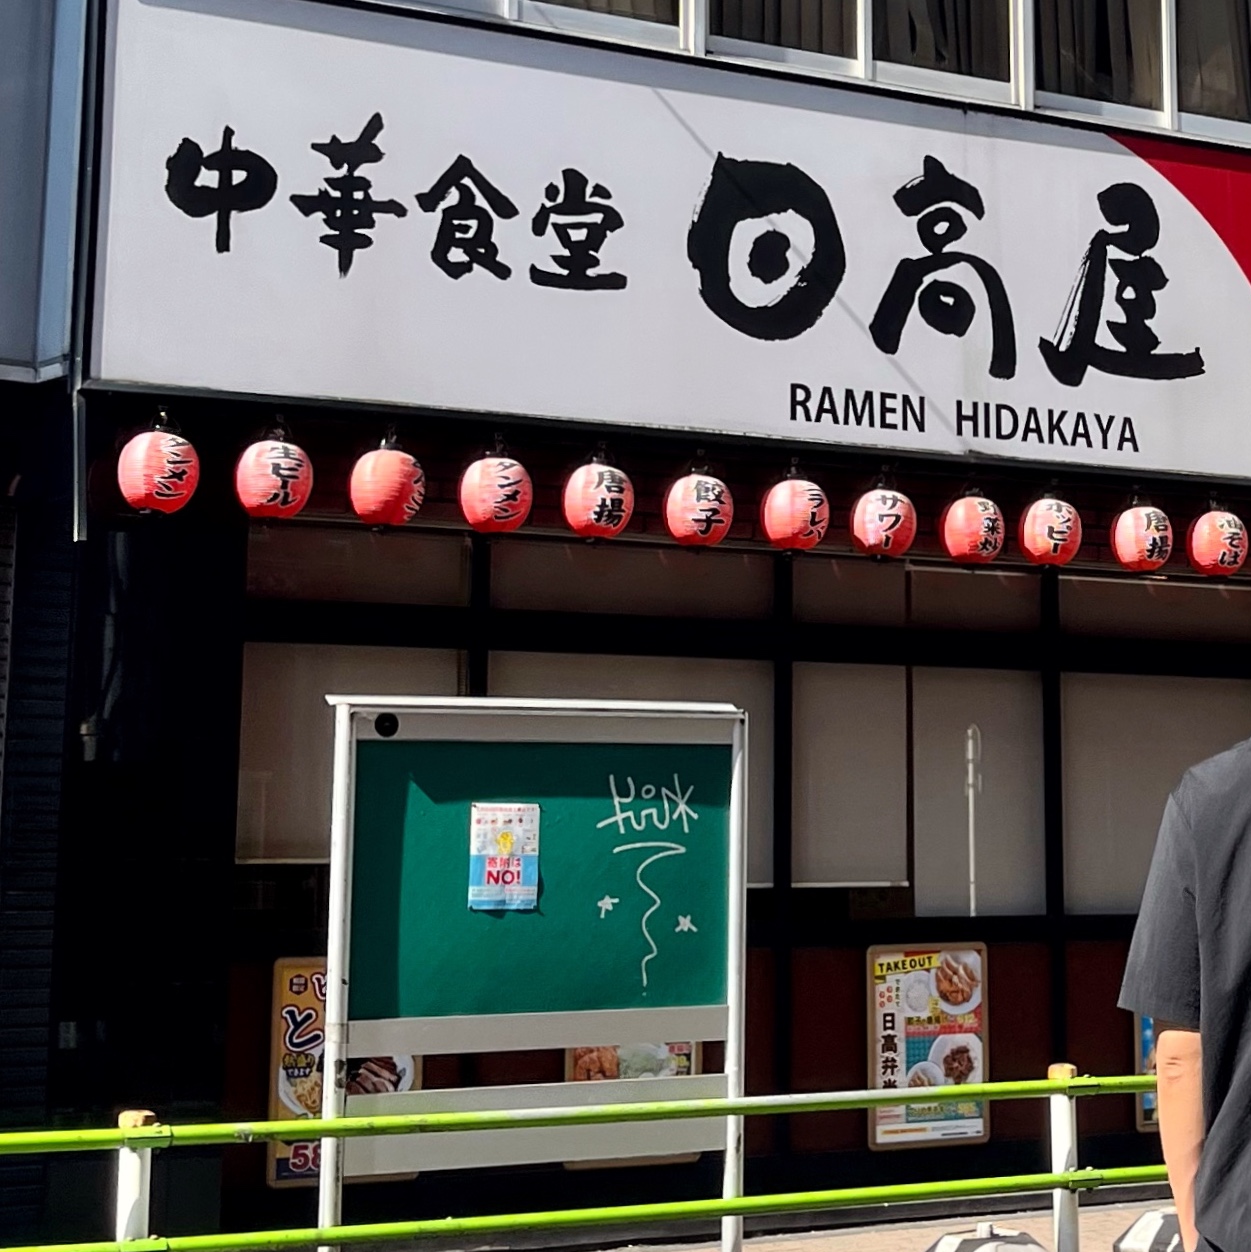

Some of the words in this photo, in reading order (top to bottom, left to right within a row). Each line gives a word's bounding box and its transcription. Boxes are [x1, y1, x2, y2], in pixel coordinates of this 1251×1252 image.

[165, 112, 627, 290] 中華食堂
[687, 151, 1205, 386] 日高屋
[788, 383, 927, 434] RAMEN
[955, 400, 1139, 454] HIDAKAYA
[266, 445, 305, 507] 生ビール
[493, 461, 522, 520] タンメン
[593, 469, 627, 528] 唐揚
[691, 480, 725, 536] 餃子
[877, 494, 904, 549] サワー
[1045, 501, 1072, 554] ホッピー
[1144, 511, 1172, 561] 唐揚
[486, 870, 521, 885] NO!
[878, 956, 933, 973] TAKEOUT
